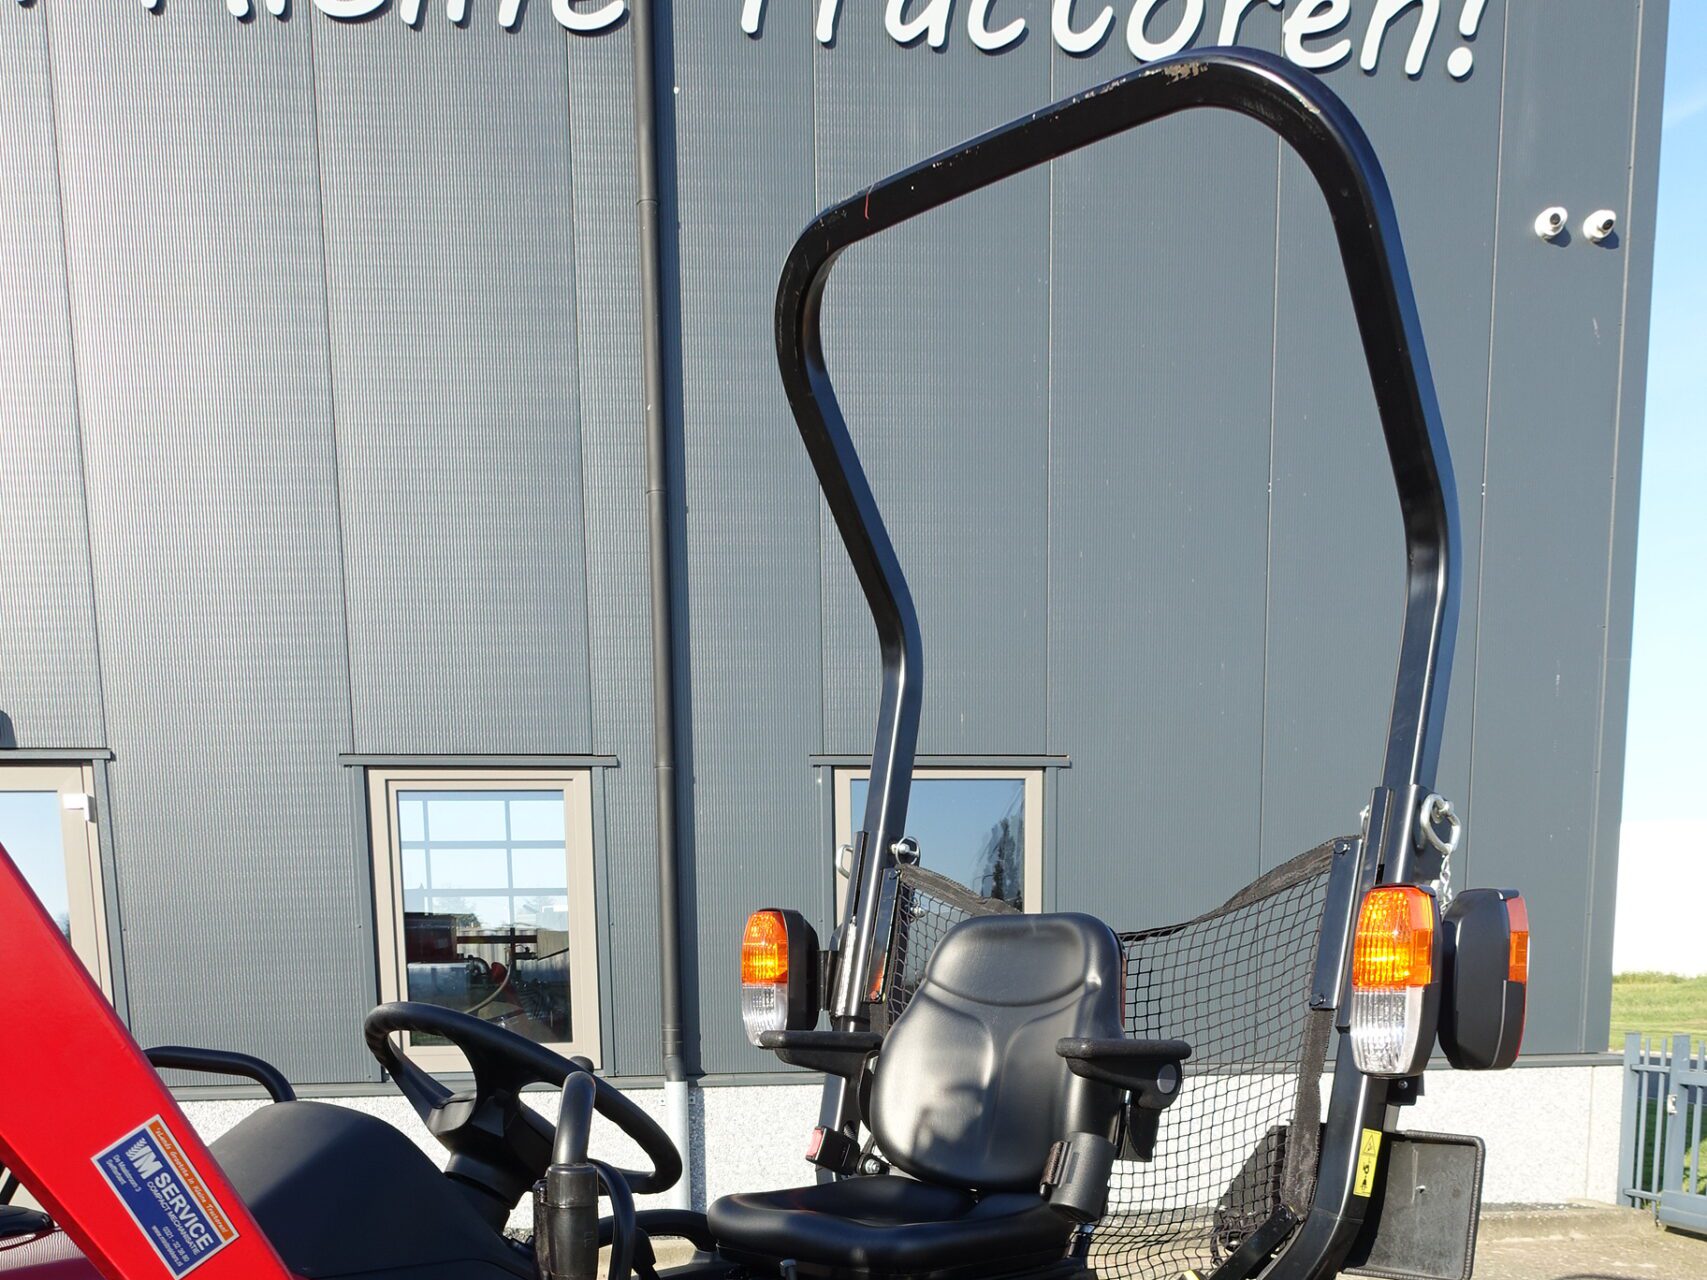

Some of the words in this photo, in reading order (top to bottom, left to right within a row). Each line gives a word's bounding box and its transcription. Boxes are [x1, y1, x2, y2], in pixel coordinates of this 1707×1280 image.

[741, 0, 1473, 77] racoren!
[146, 1181, 170, 1212] COMPACT
[167, 1209, 200, 1255] MECHANISATIE
[154, 1172, 214, 1251] SERVICE
